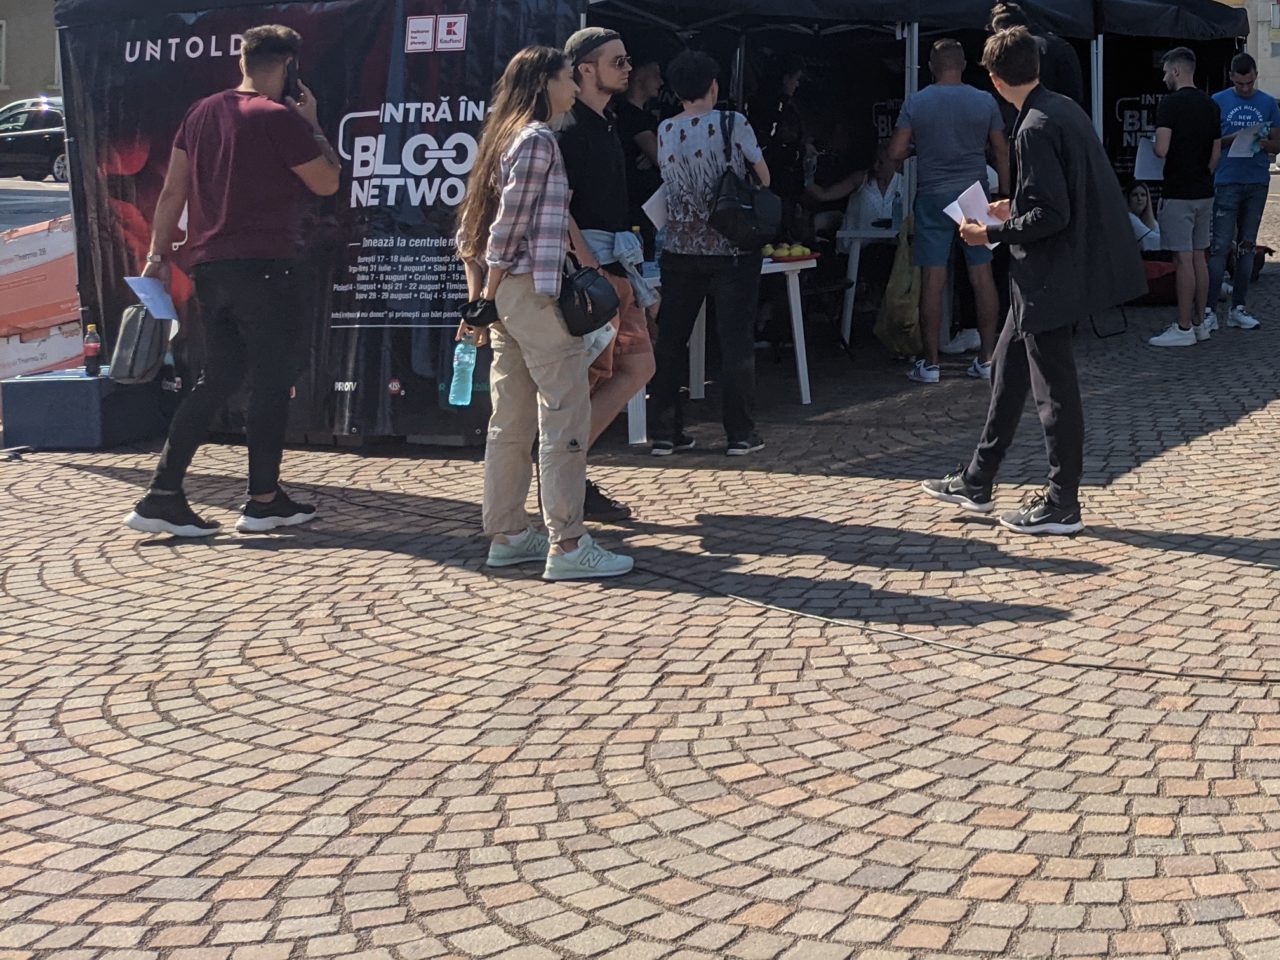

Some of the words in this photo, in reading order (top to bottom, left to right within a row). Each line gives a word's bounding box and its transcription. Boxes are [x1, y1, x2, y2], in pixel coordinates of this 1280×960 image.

[124, 33, 244, 63] UNTOLD
[379, 96, 453, 123] INTRĂ
[458, 96, 485, 122] ÎN
[352, 132, 480, 178] BLOO
[350, 177, 466, 209] NETWO
[396, 236, 406, 247] la
[408, 236, 447, 247] centrele
